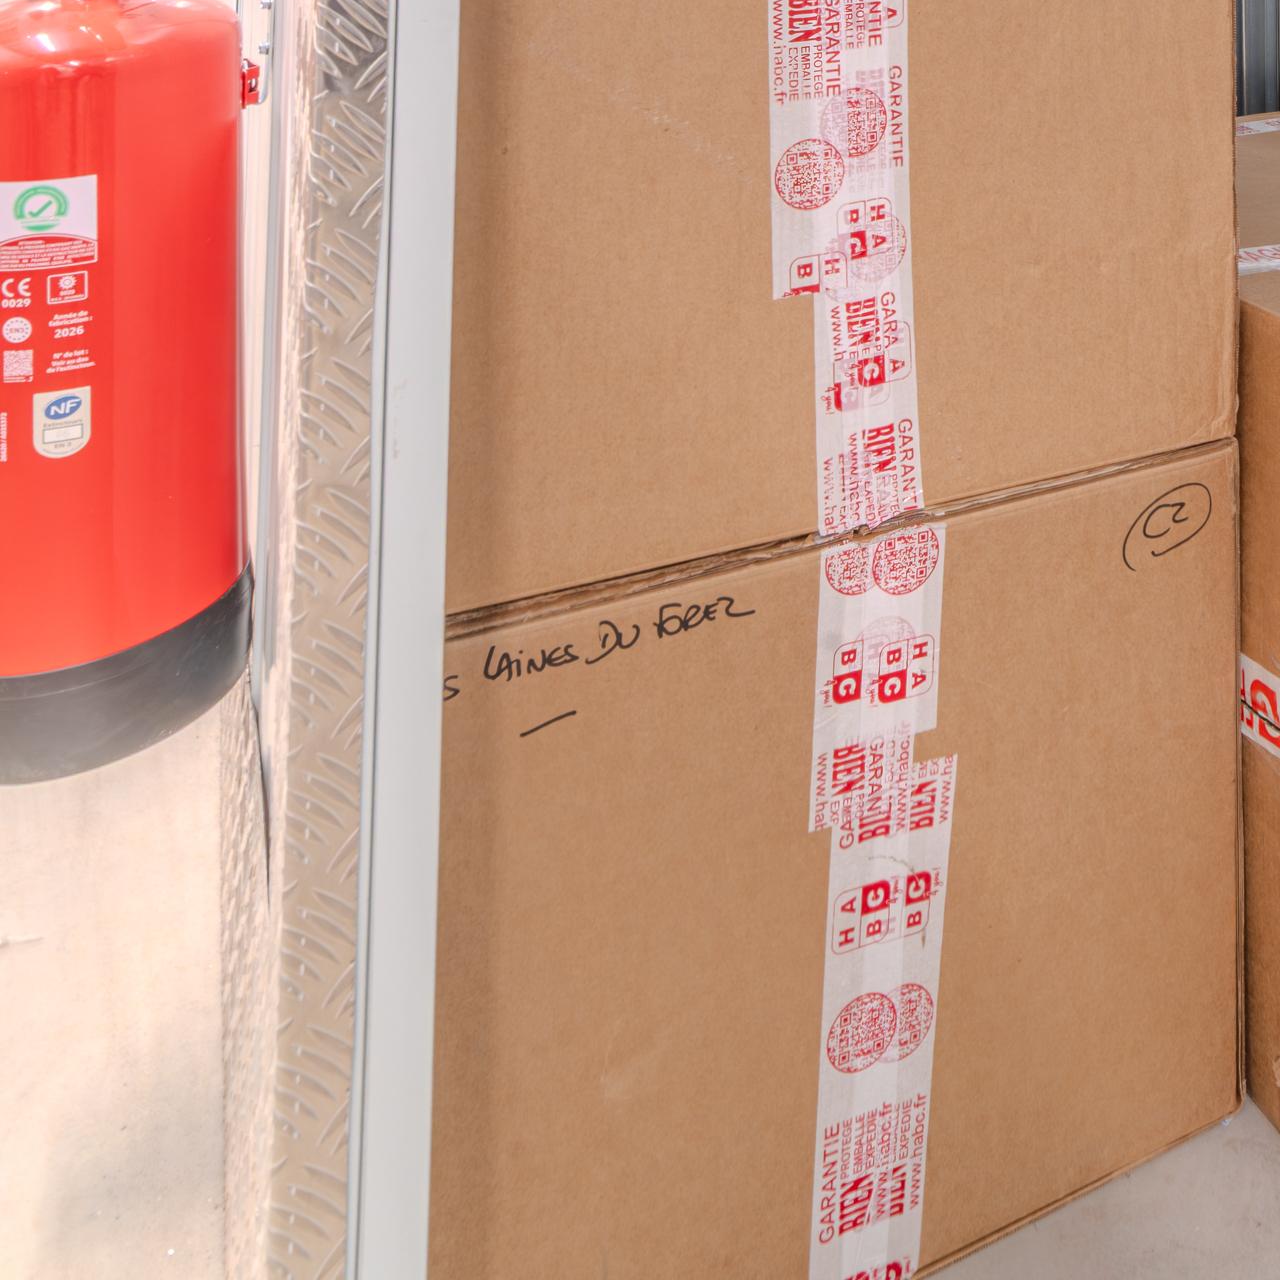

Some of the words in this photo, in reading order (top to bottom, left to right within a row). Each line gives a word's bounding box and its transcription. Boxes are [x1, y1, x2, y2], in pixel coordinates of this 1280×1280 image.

[813, 44, 824, 99] PROTEGE
[1, 298, 32, 308] 0029
[53, 325, 85, 338] 2026
[50, 398, 81, 416] NF
[831, 743, 866, 797] BIEN
[840, 1118, 853, 1180] PROTEGE
[853, 1112, 866, 1175] EMBALLE
[865, 1107, 878, 1171] EXPEDIE
[899, 1097, 913, 1161] EXPEDIE
[909, 1092, 927, 1211] www.habc.fr
[818, 1121, 841, 1245] GARANTIE
[838, 1172, 874, 1237] BIEN
